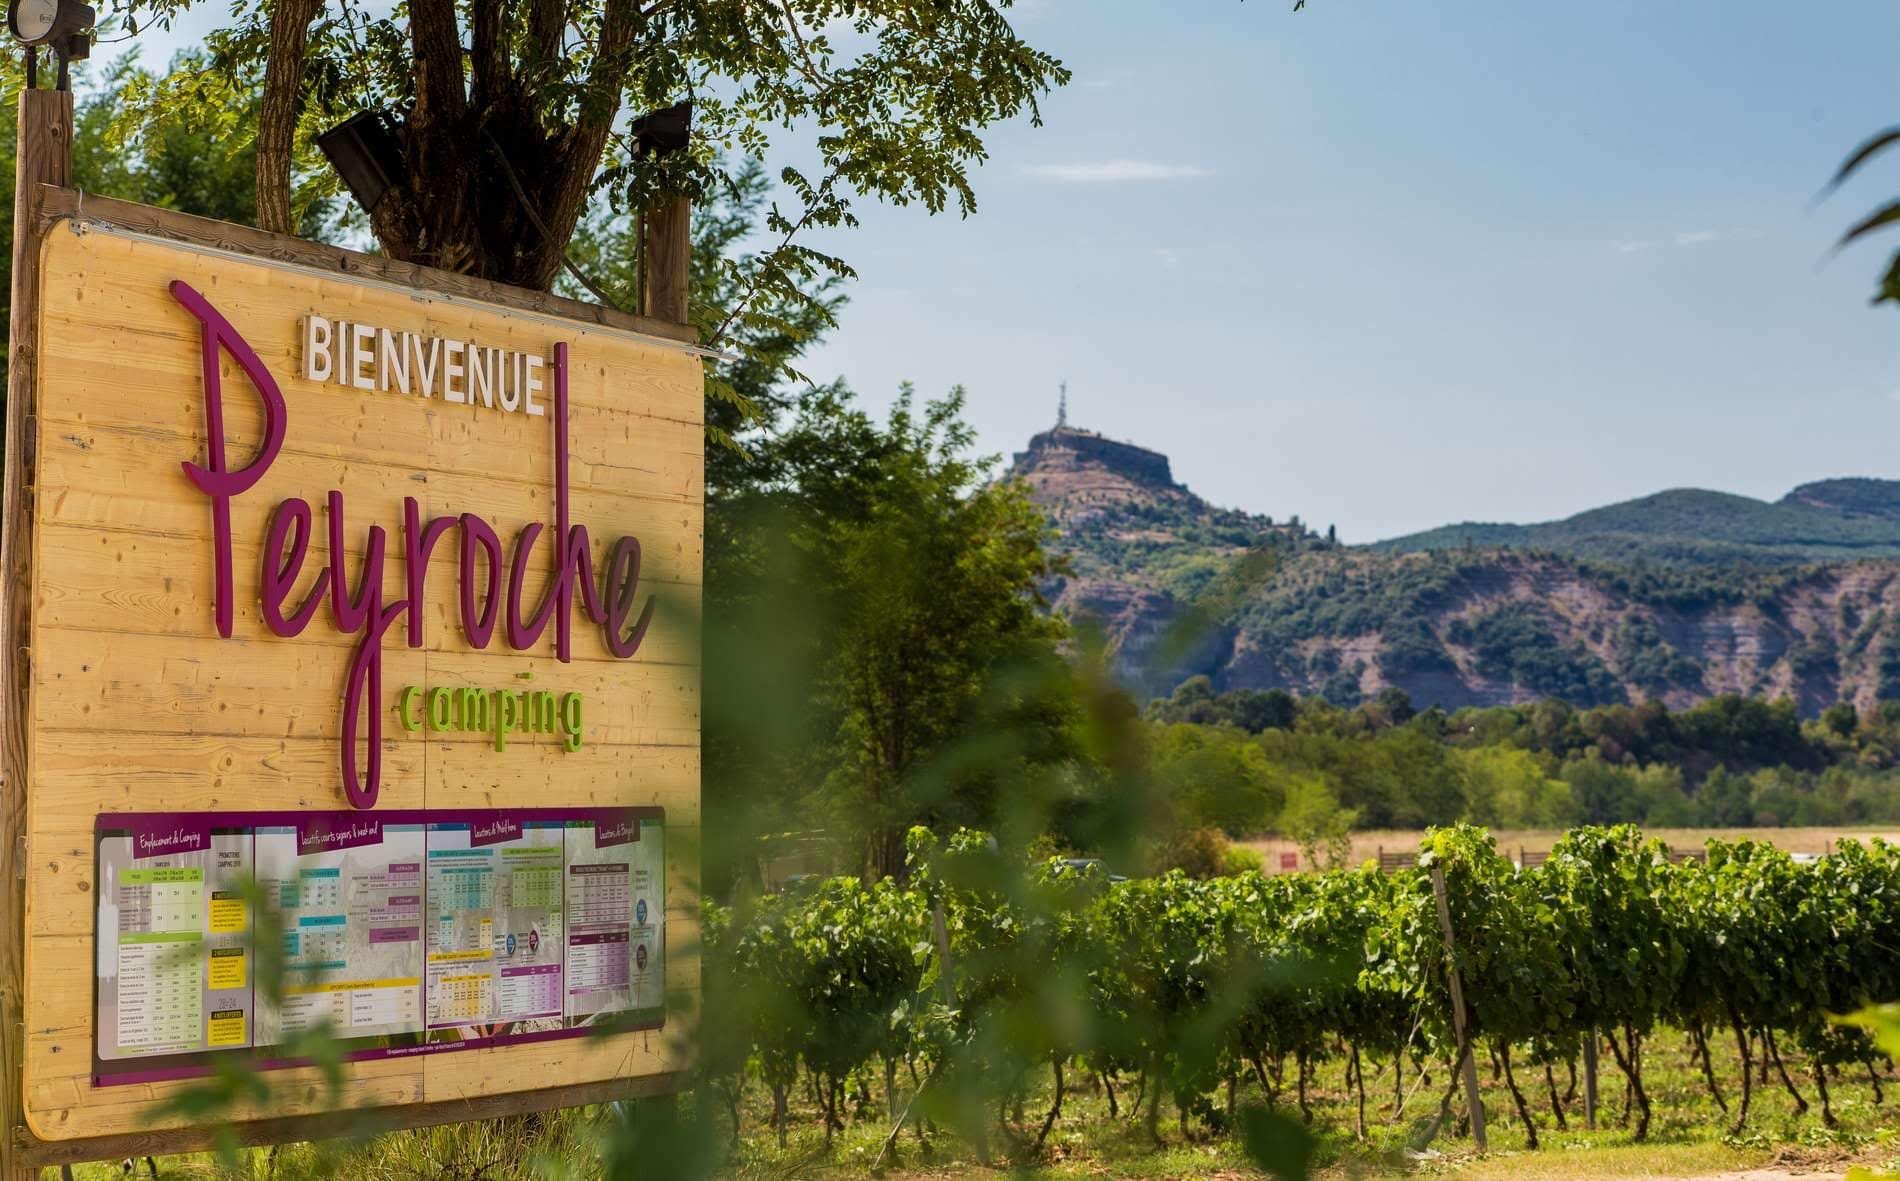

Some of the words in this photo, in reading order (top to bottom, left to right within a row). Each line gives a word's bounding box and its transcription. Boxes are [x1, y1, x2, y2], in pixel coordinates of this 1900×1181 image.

[304, 315, 546, 417] BIENVENUE
[168, 279, 656, 810] Peyroche
[400, 671, 585, 752] camping
